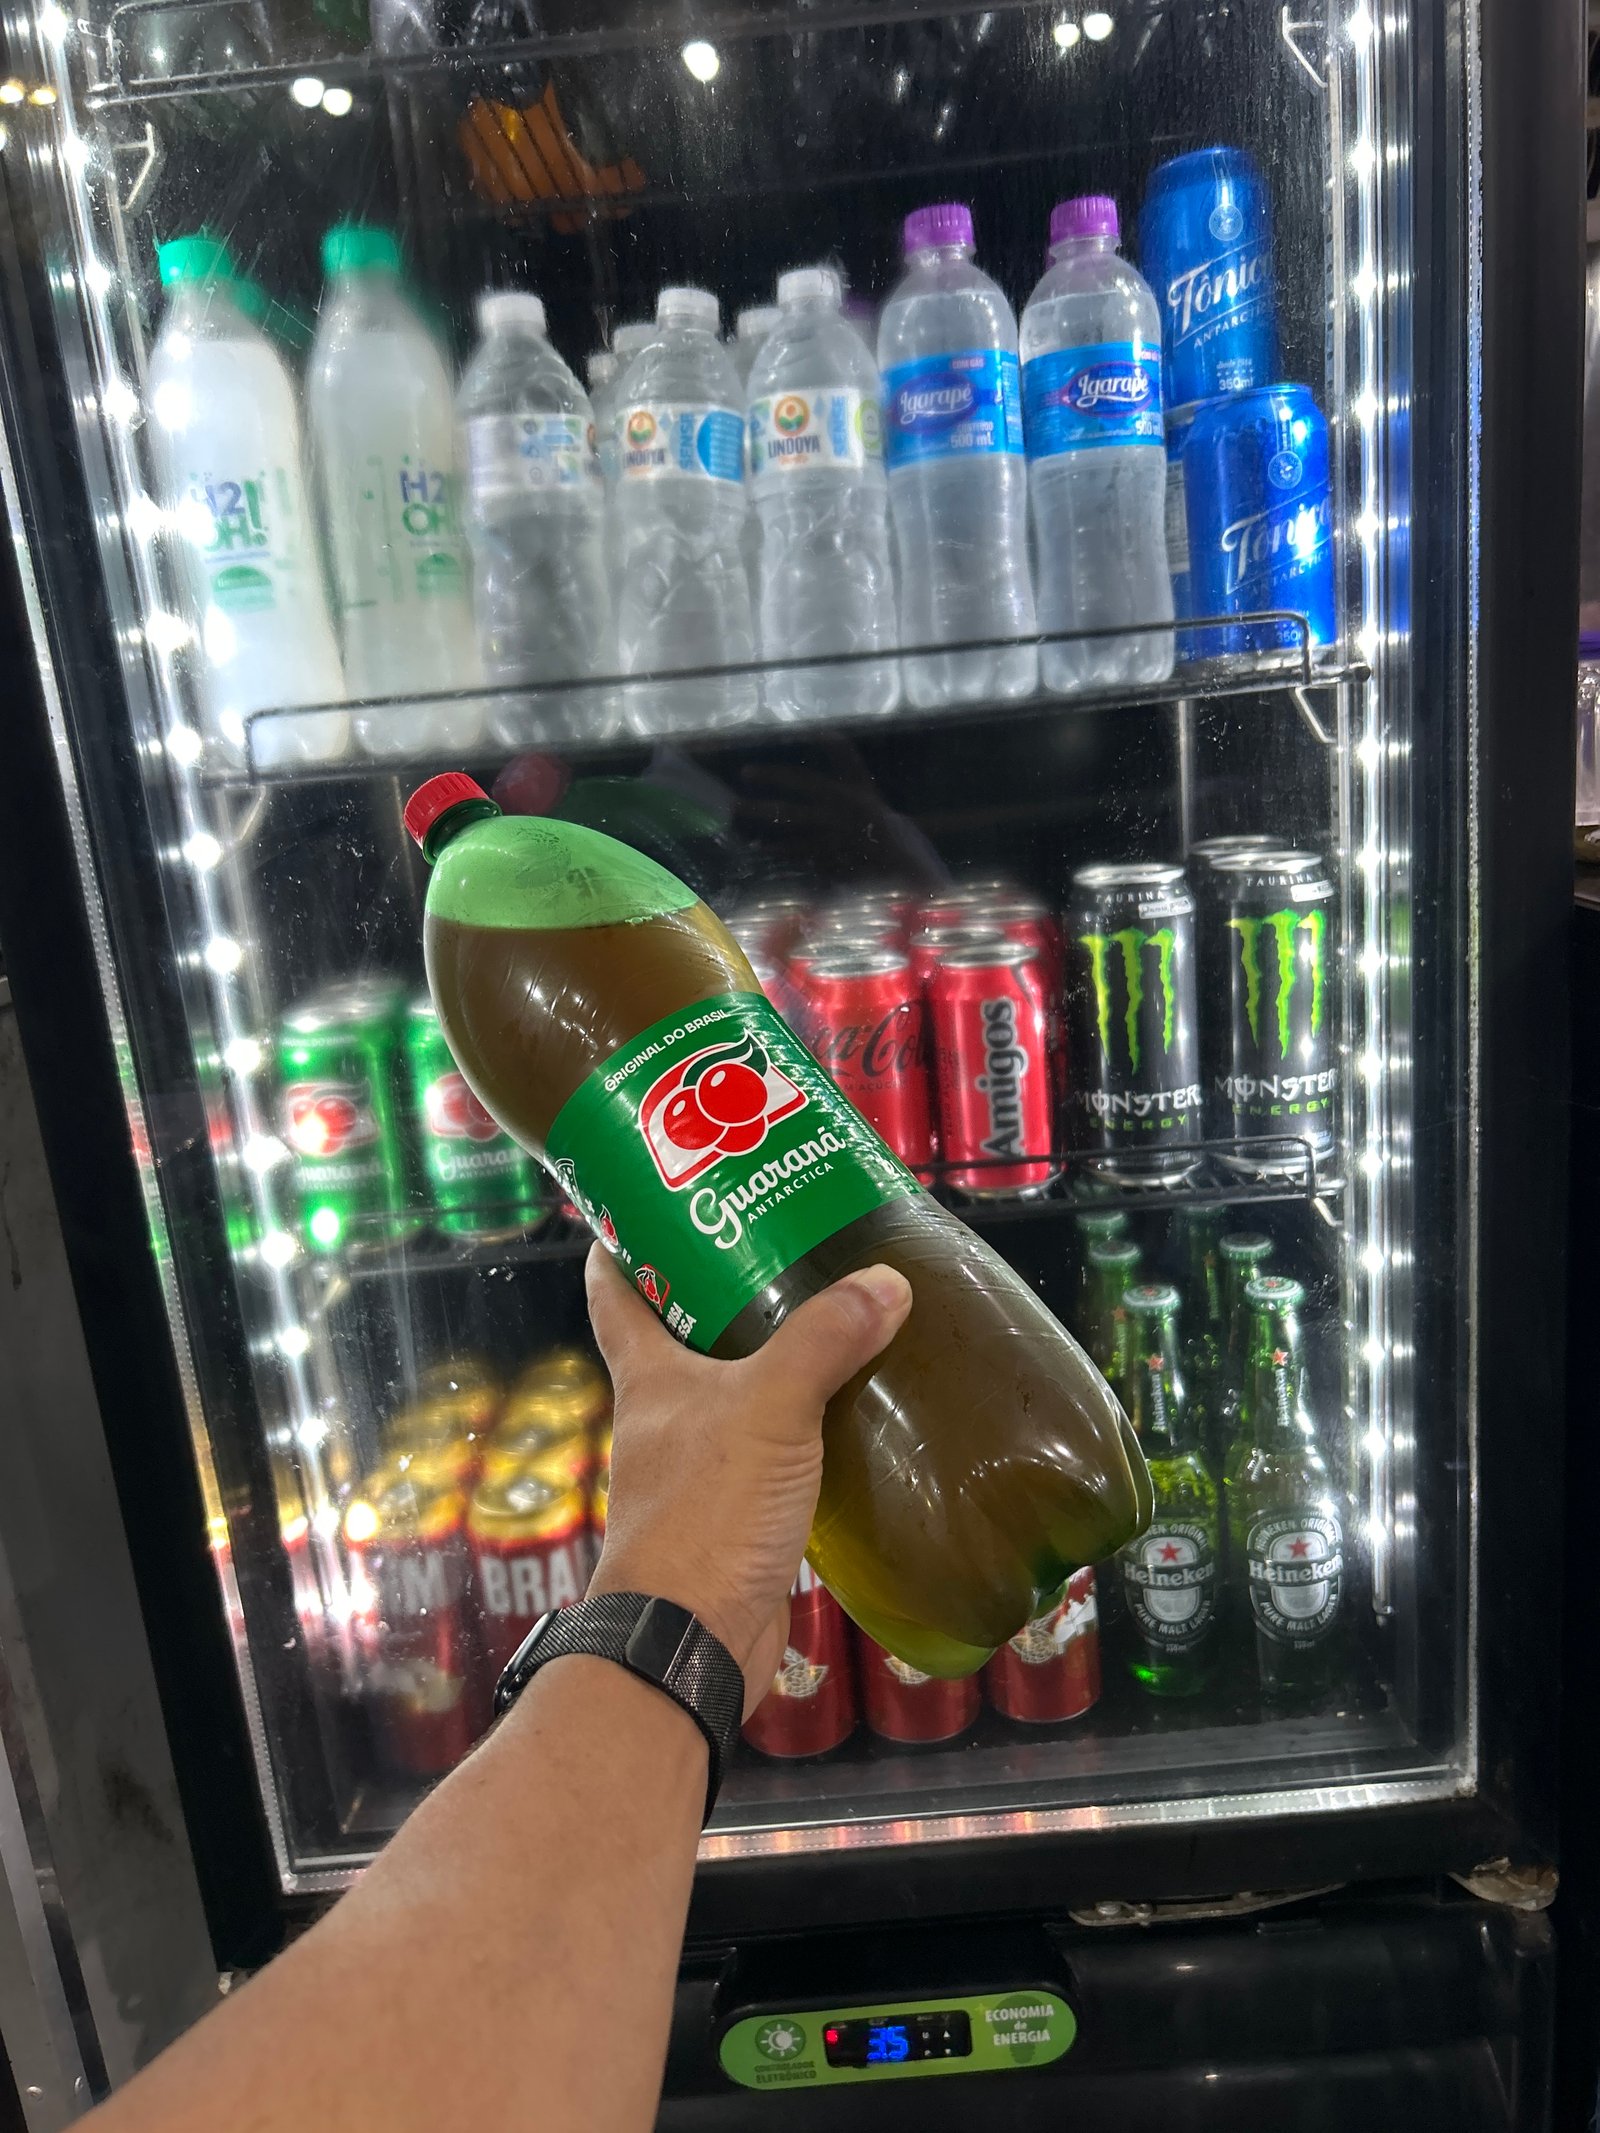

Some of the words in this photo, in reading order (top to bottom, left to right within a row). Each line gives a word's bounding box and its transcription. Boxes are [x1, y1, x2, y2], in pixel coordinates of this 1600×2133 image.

[1076, 371, 1150, 408] Igarapé
[1219, 377, 1253, 390] 350ml
[901, 383, 974, 425] Igarapé
[951, 434, 973, 449] 500
[1246, 873, 1314, 888] TAURINA
[1095, 889, 1166, 903] TAURINA
[604, 1041, 666, 1092] ORIGINAL
[663, 1028, 686, 1046] DO
[684, 1009, 731, 1034] BRASIL
[976, 997, 1028, 1158] Amigos
[1215, 1067, 1337, 1101] MONSTER
[1074, 1082, 1202, 1118] MONSTER
[1231, 1097, 1331, 1116] ENERGY
[689, 1127, 847, 1249] Guaraná
[747, 1162, 835, 1225] ANTARCTICA
[1123, 1560, 1215, 1587] Heineken
[1248, 1553, 1343, 1584] Heineken
[1158, 1622, 1188, 1635] MALT
[1286, 1619, 1315, 1632] MALT
[985, 2004, 1055, 2022] ECONOMIA
[1014, 2019, 1027, 2031] de
[993, 2029, 1051, 2046] ENERGIA
